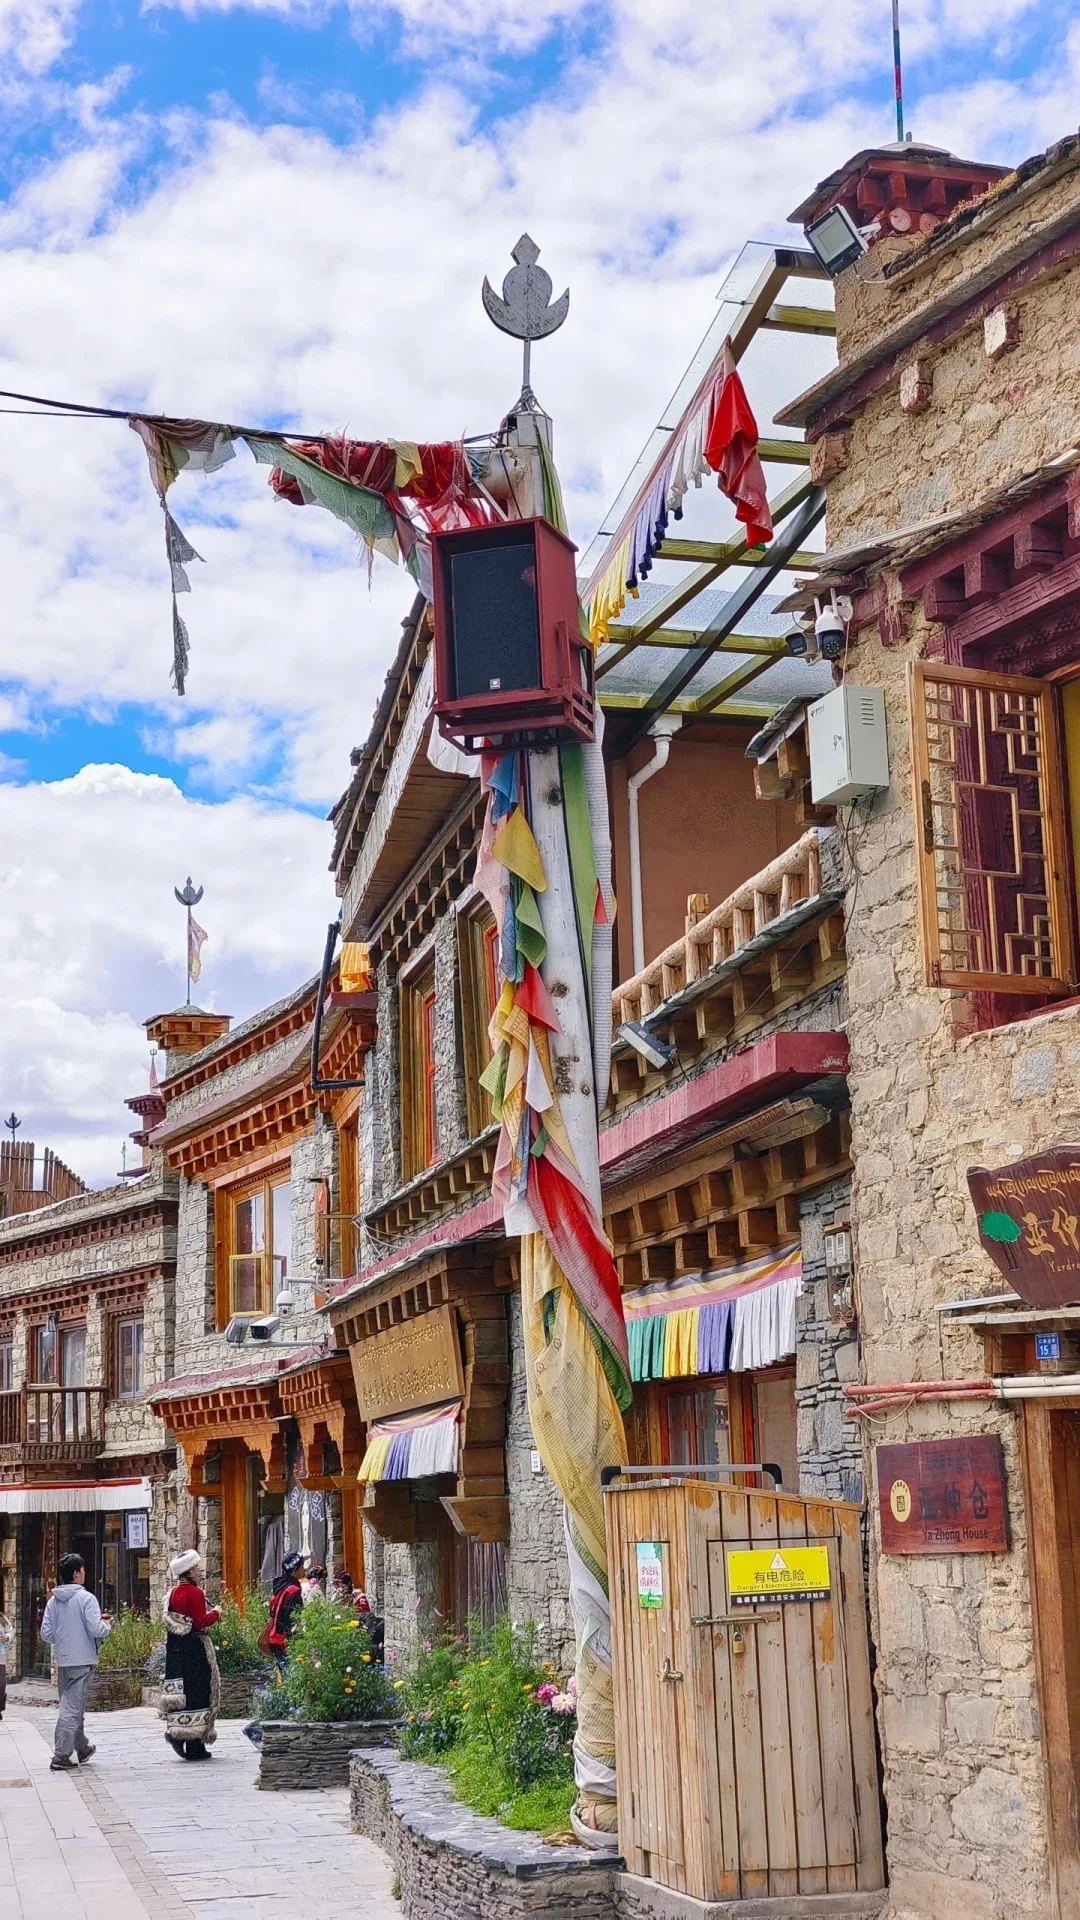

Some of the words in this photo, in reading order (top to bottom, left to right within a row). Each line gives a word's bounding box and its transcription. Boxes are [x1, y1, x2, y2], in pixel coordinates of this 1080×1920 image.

[1039, 1344, 1049, 1356] 15
[922, 1528, 933, 1541] Ya
[935, 1528, 961, 1542] Zhong
[963, 1527, 989, 1540] House
[753, 1569, 805, 1584] 有电危险
